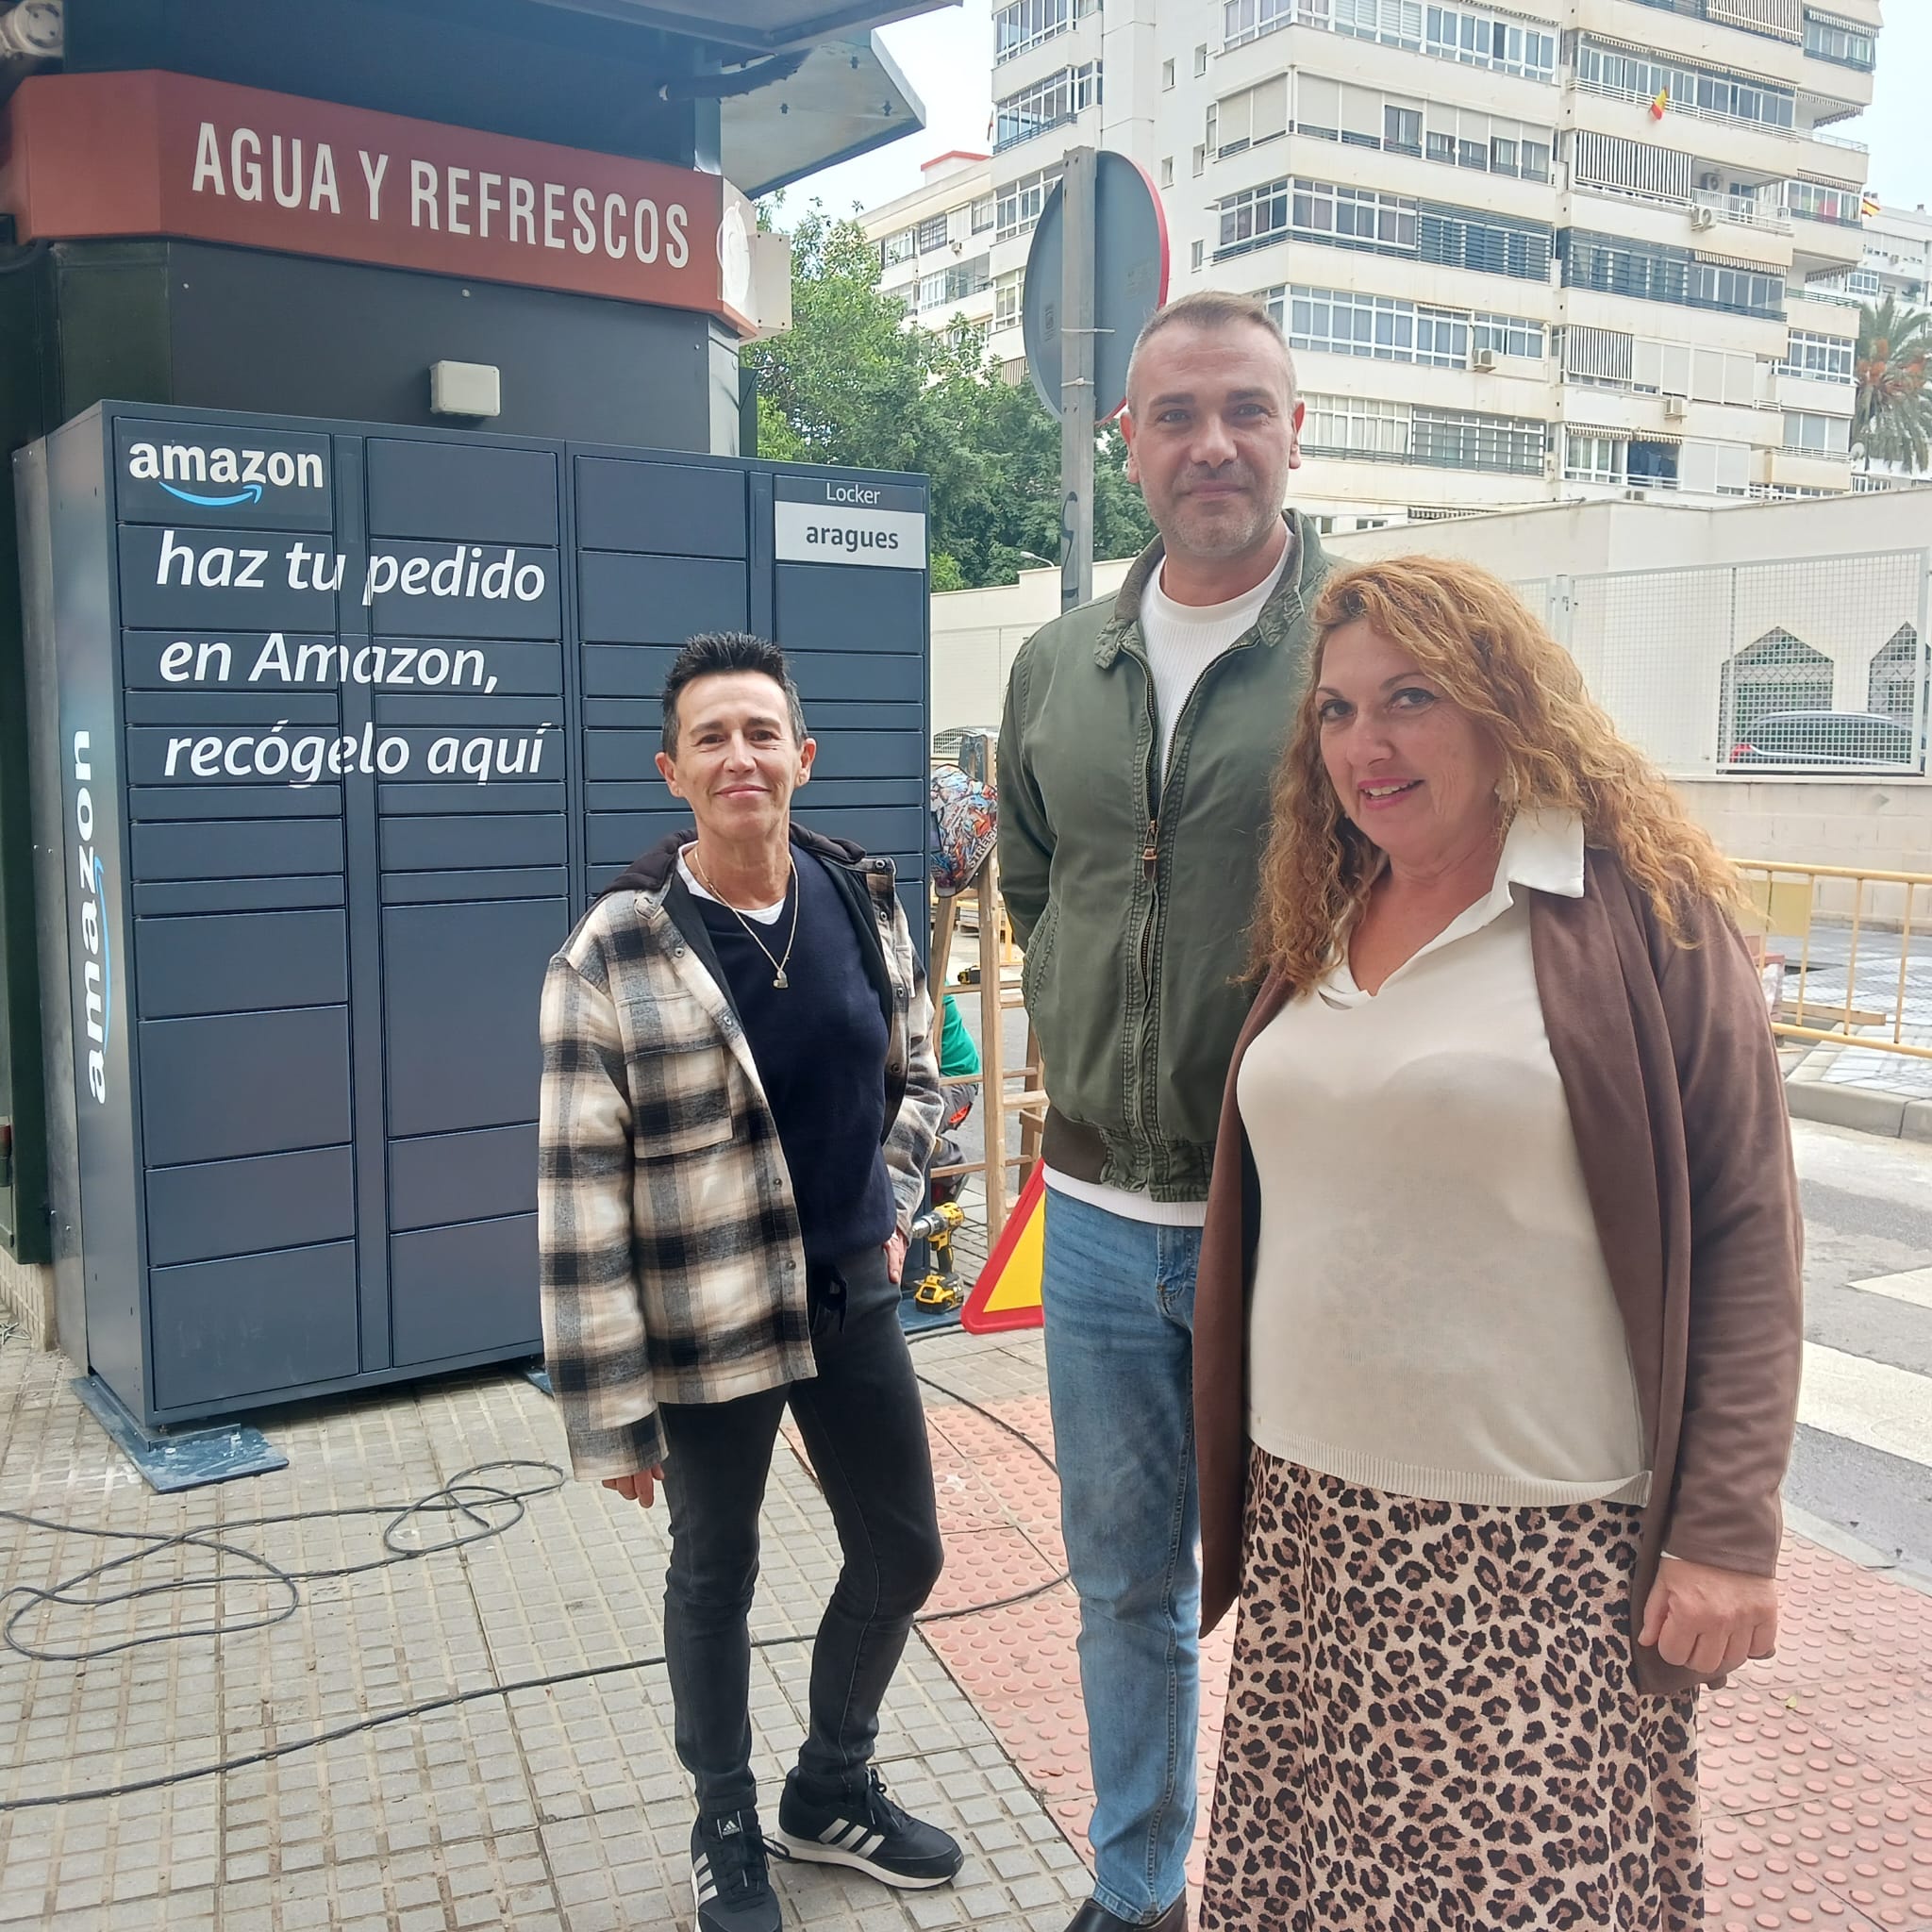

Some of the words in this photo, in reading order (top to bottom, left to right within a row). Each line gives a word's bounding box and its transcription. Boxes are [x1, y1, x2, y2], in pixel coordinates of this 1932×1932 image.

[192, 122, 341, 214] AGUA
[358, 150, 390, 222] Y
[410, 160, 690, 270] REFRESCOS
[129, 441, 324, 489] amazon
[826, 483, 881, 505] Locker
[156, 529, 269, 589] haz
[285, 541, 345, 591] tu
[361, 546, 546, 607] pedido
[806, 525, 899, 553] aragues
[158, 639, 232, 682] en
[248, 632, 499, 694] Amazon,
[163, 719, 409, 789] recógelo
[426, 722, 553, 786] aquí
[73, 730, 106, 1105] amazon
